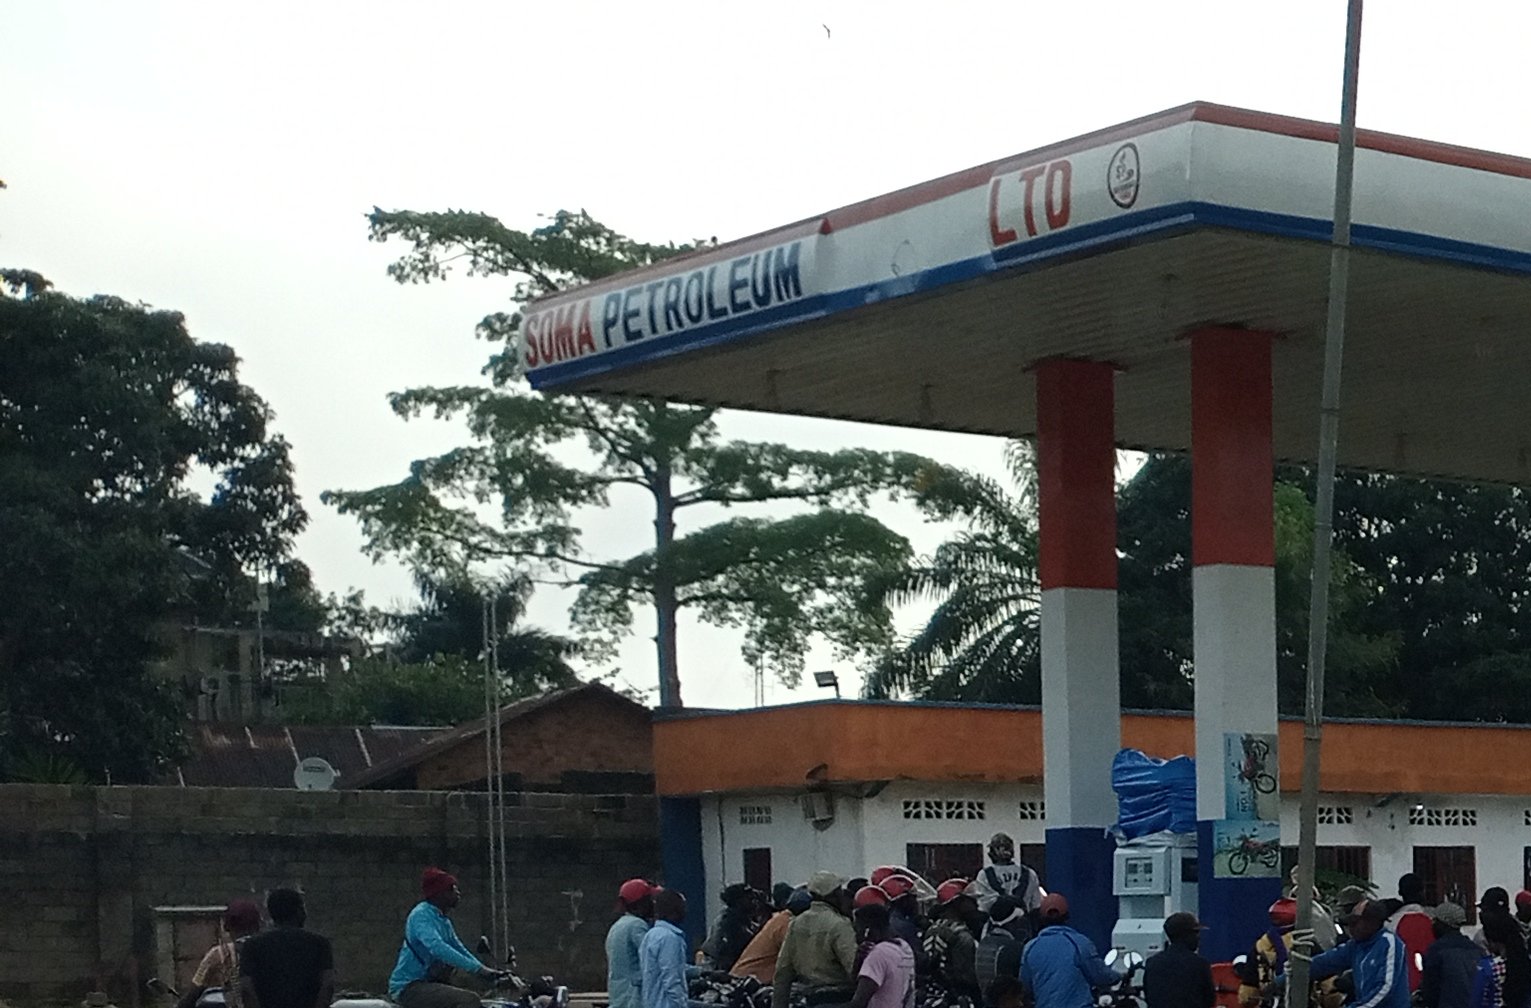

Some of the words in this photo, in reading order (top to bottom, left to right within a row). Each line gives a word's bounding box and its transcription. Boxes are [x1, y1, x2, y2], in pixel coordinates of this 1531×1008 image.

[525, 300, 597, 368] SOMA
[602, 242, 803, 348] PETROLEUM
[989, 159, 1072, 246] LTD
